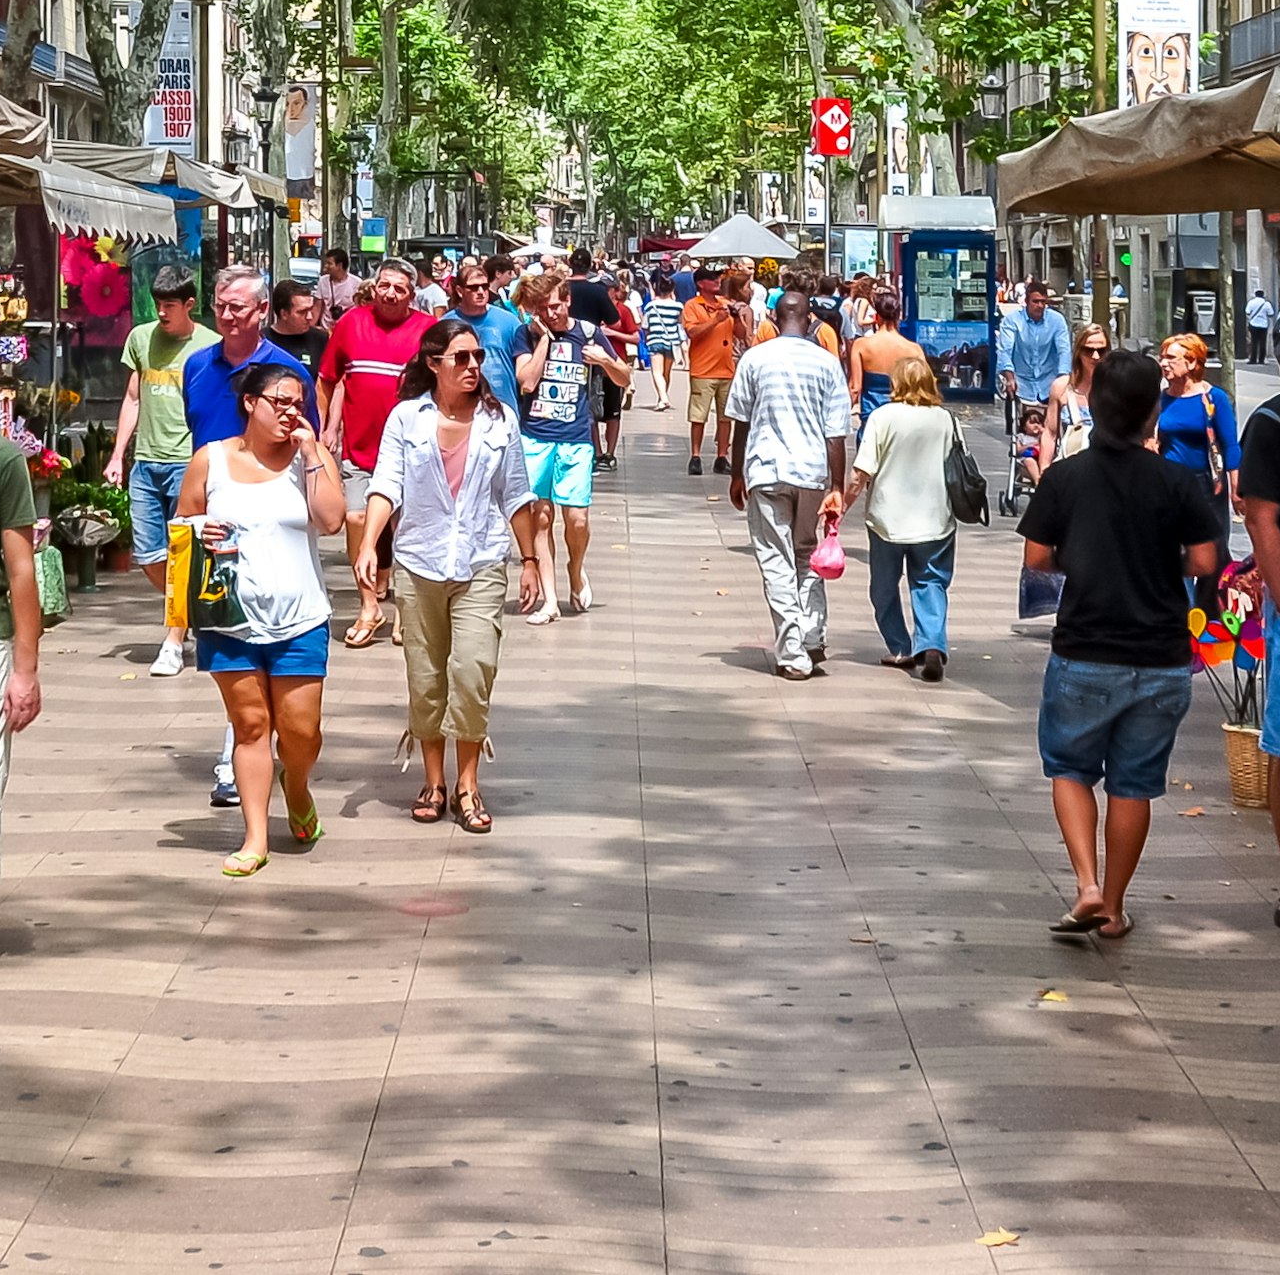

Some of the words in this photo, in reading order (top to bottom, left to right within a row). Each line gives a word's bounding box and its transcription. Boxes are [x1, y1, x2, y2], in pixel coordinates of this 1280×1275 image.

[160, 58, 191, 74] ORAR
[158, 74, 191, 90] PARIS
[150, 90, 191, 106] CASSO
[163, 106, 191, 122] 1900
[831, 113, 842, 125] M
[163, 122, 192, 138] 1907
[540, 384, 577, 400] LOVE
